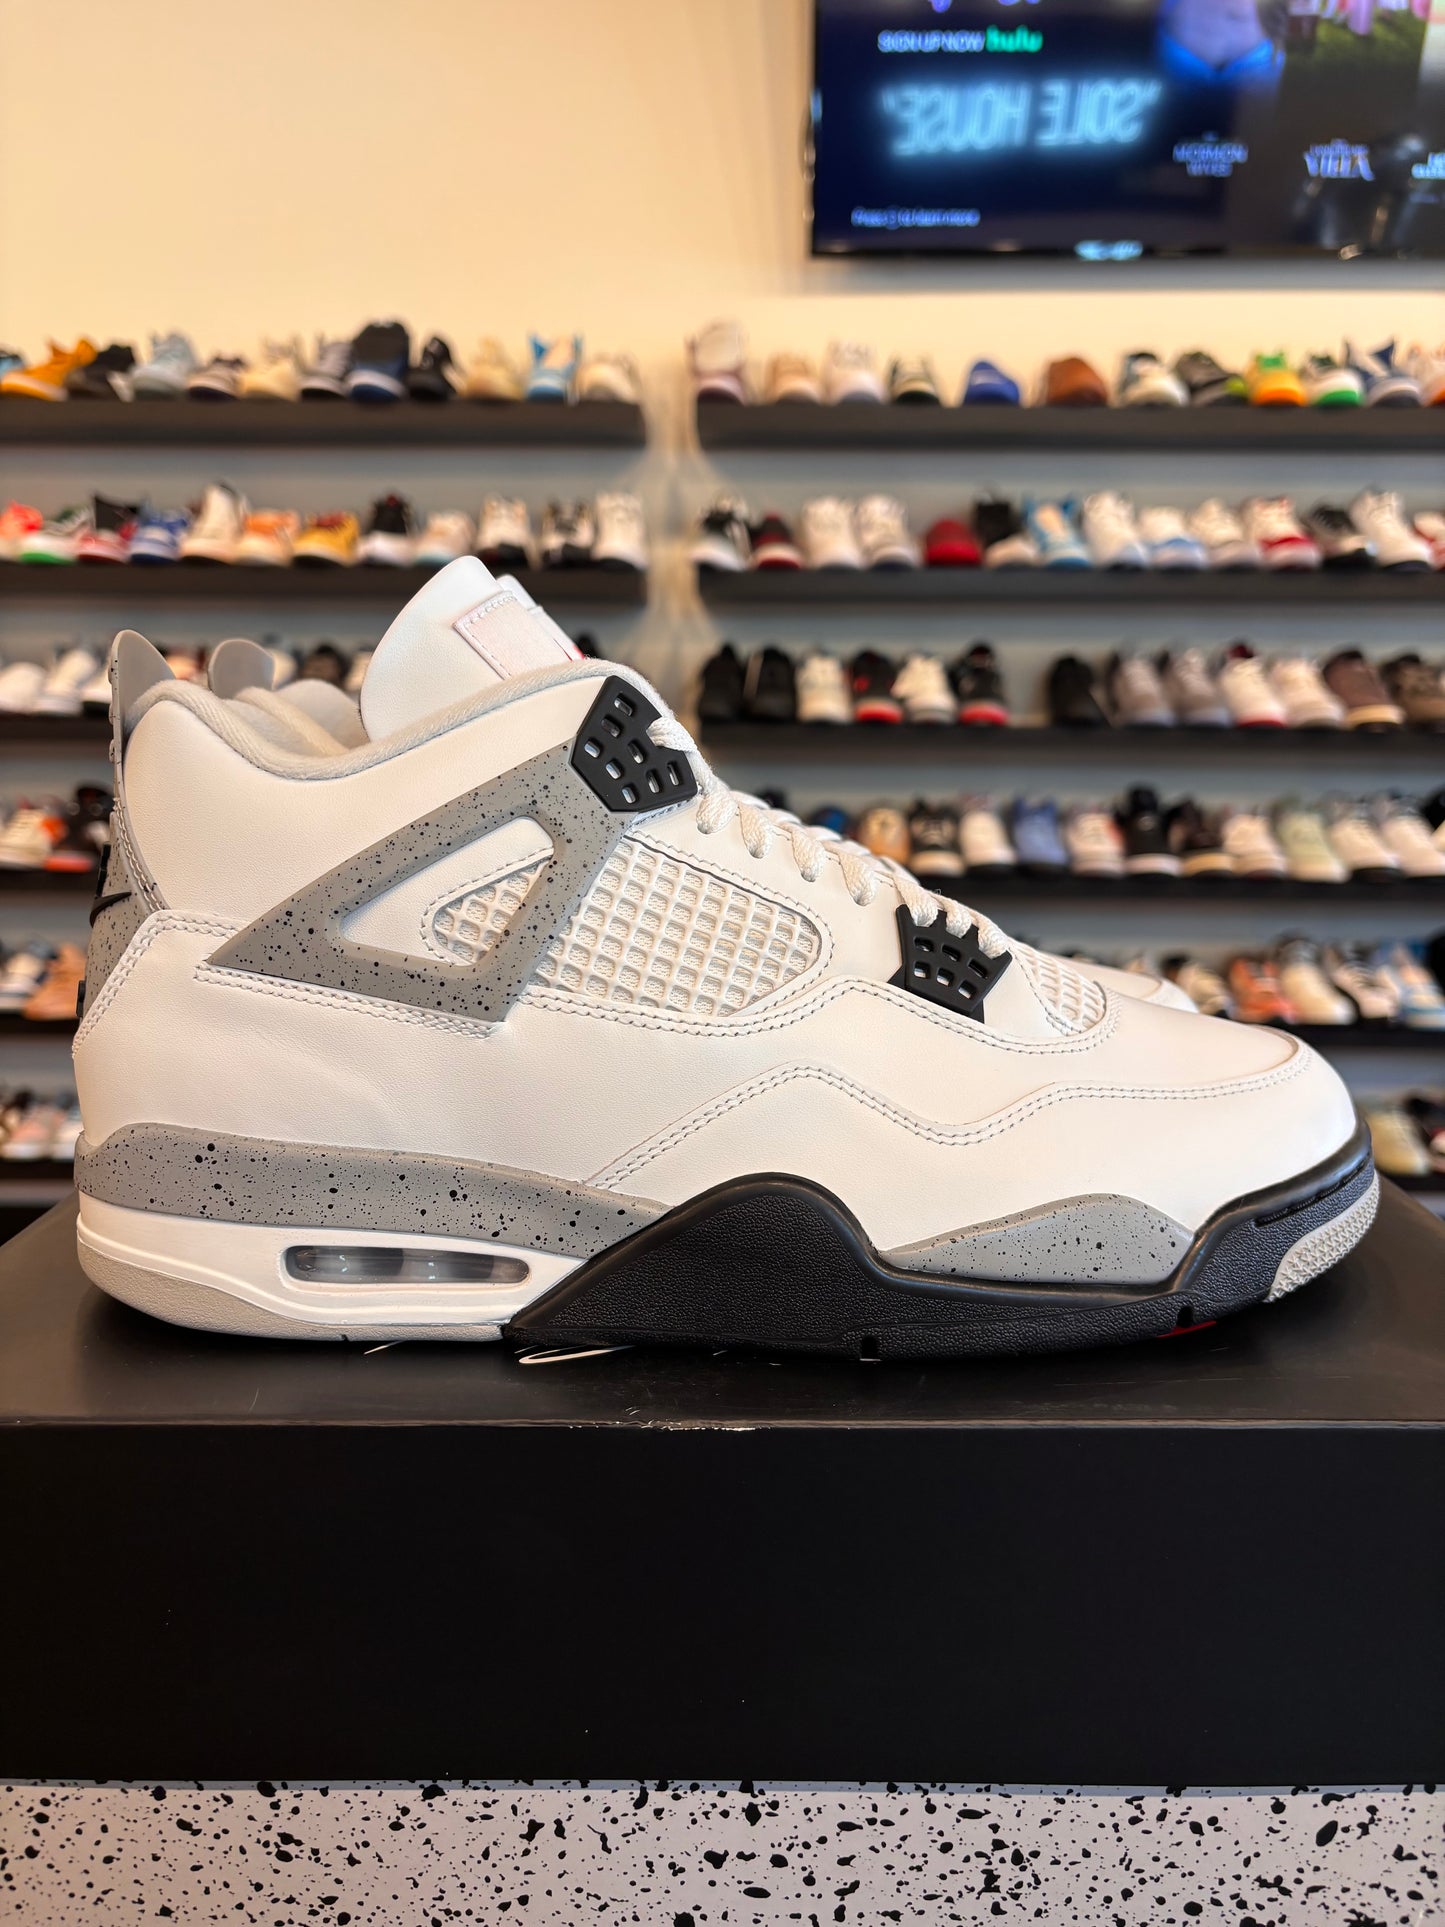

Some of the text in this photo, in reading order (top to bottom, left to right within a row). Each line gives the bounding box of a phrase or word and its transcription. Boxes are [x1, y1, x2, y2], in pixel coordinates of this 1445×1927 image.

[877, 25, 1043, 53] SIGN UP NOW hulu
